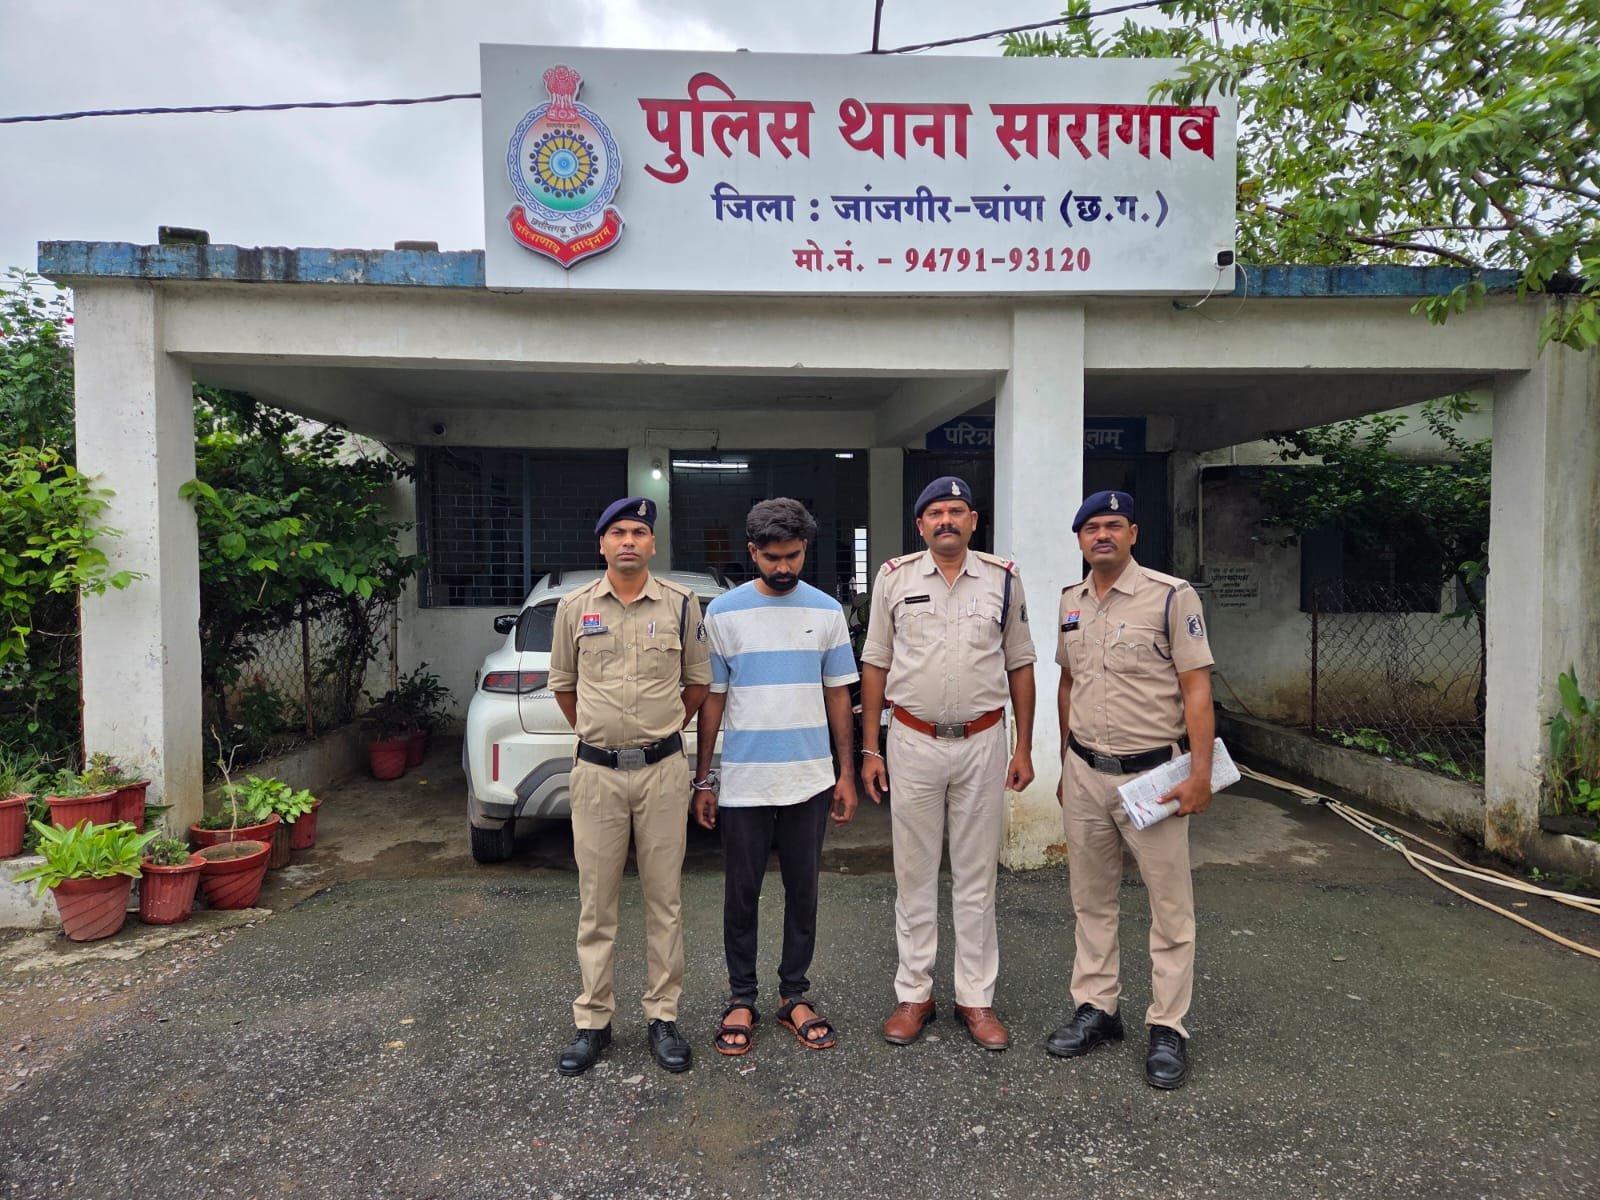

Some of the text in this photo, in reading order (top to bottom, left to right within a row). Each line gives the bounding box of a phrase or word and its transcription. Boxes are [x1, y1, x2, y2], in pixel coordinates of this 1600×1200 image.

[639, 71, 815, 184] पुलिस
[838, 97, 973, 161] थाना
[710, 182, 796, 223] जिला
[830, 183, 1047, 223] जांजगीर-चांपा
[1059, 189, 1169, 229] (छ.ग.)
[792, 239, 864, 272] मो.नं.
[905, 247, 1091, 272] 94791-93120
